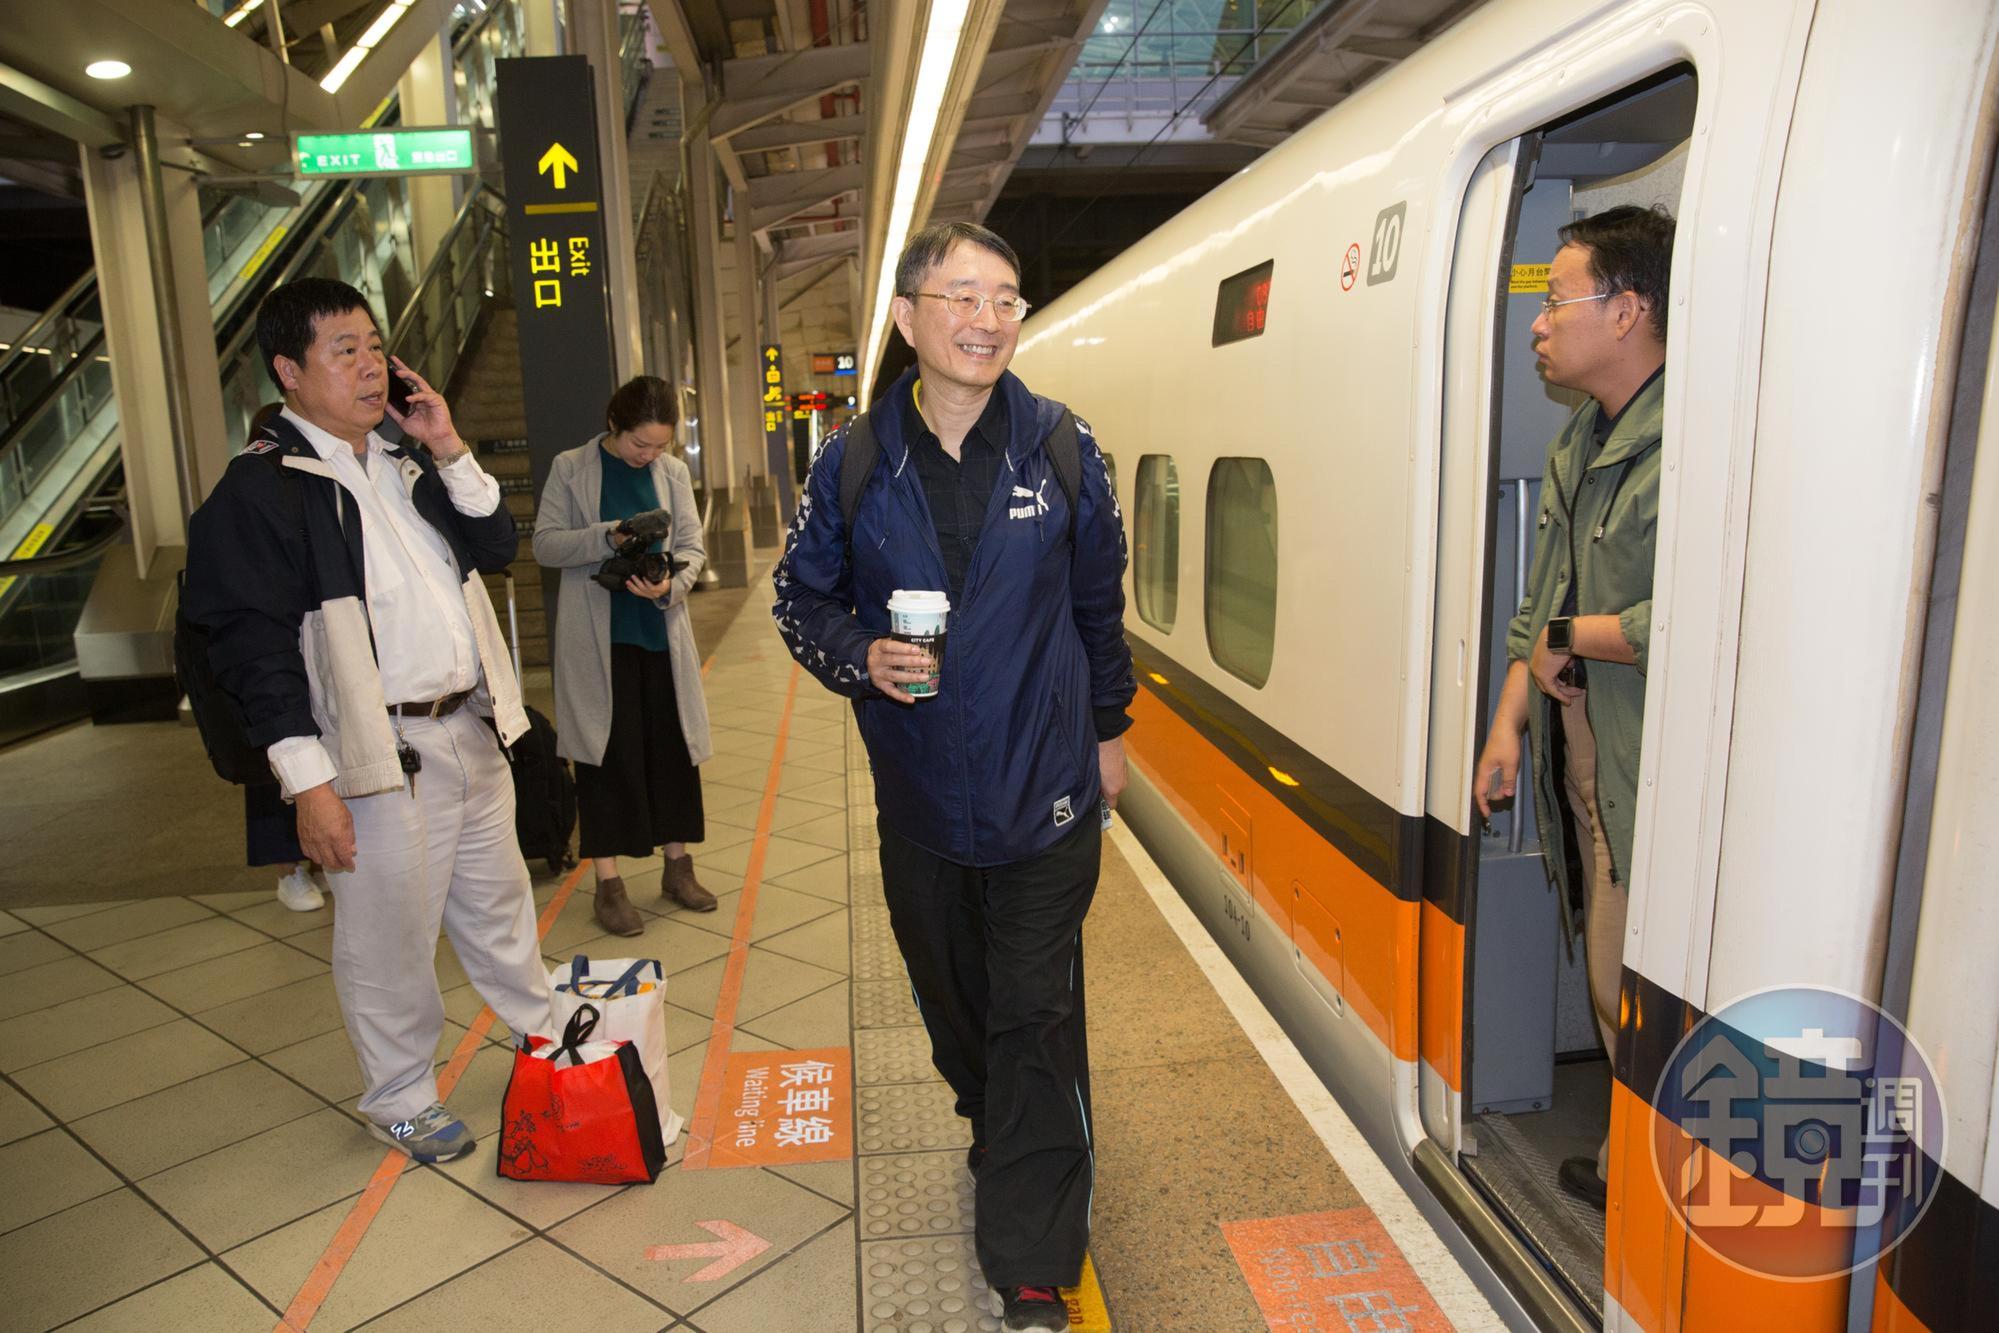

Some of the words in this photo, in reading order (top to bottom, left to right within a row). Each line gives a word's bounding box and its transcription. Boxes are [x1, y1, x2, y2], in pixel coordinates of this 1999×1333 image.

[316, 153, 361, 168] EXIT
[568, 237, 591, 276] Exit
[1371, 214, 1400, 276] 10
[530, 238, 562, 308] 出口
[837, 355, 854, 370] 10
[734, 1066, 770, 1118] Waiting
[774, 1060, 835, 1148] 候車線
[735, 1119, 767, 1148] line
